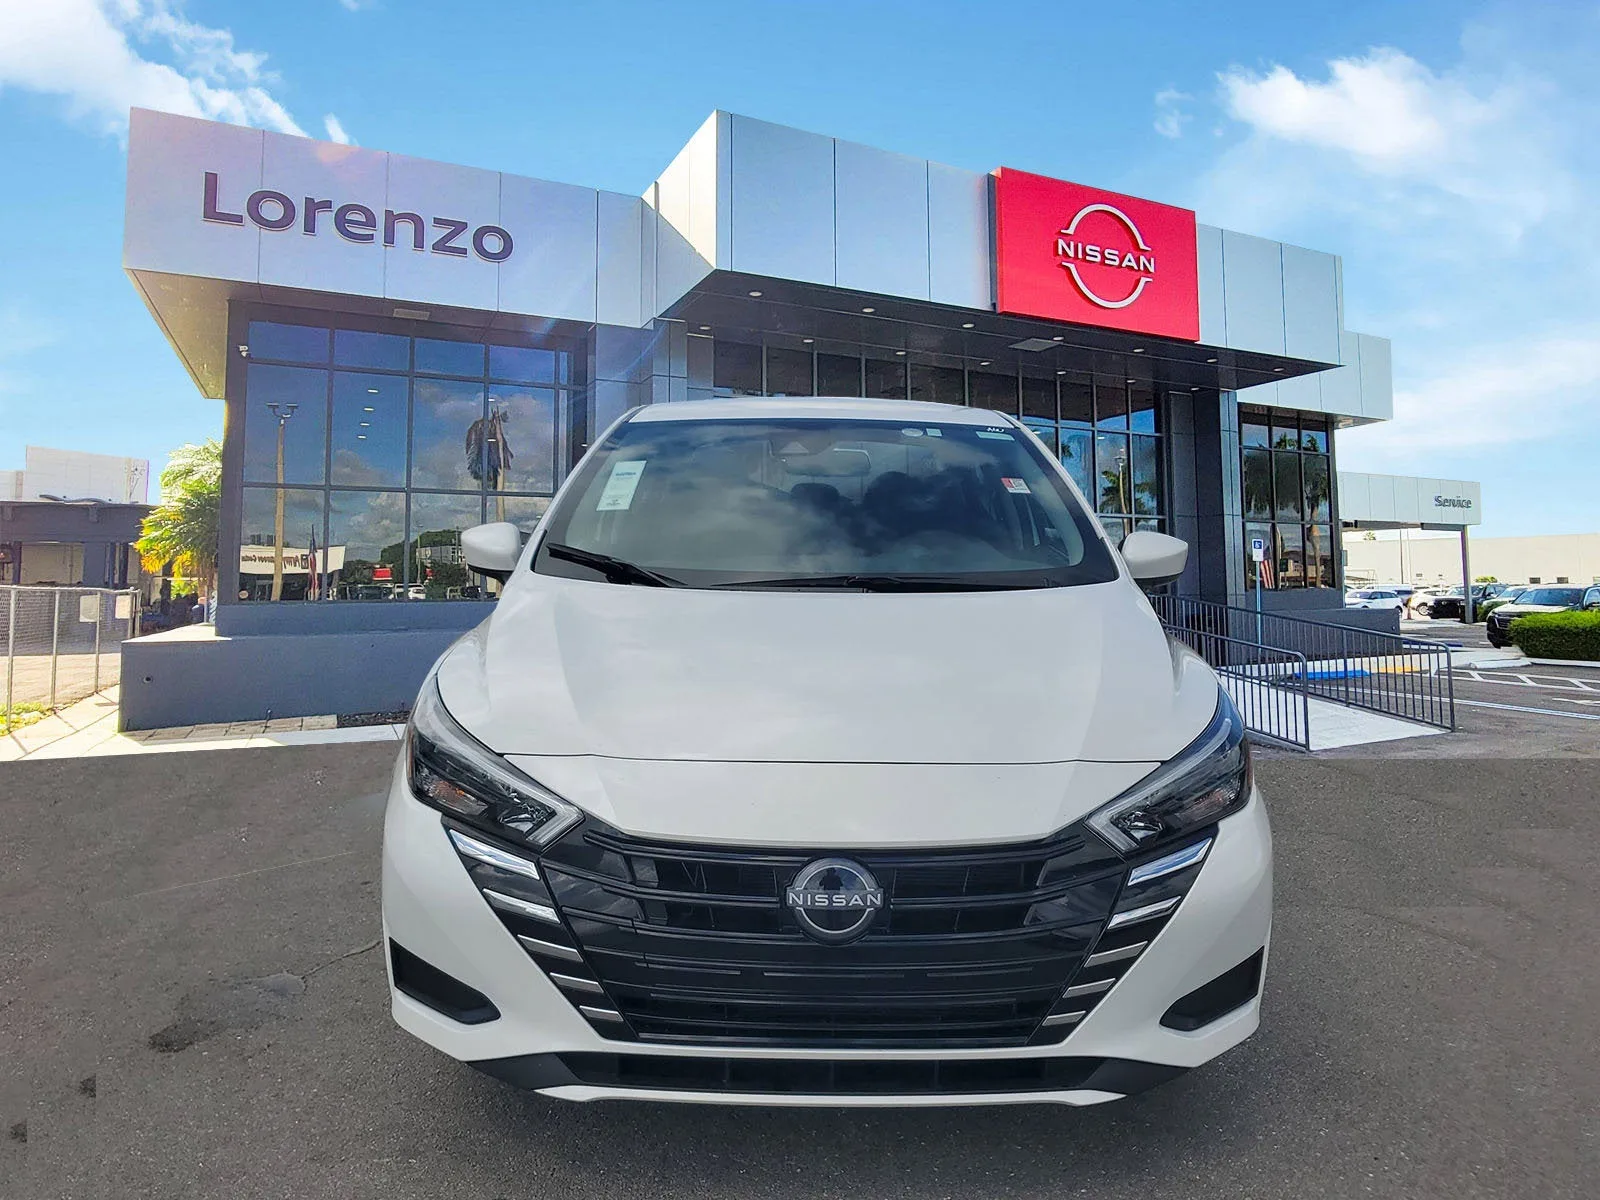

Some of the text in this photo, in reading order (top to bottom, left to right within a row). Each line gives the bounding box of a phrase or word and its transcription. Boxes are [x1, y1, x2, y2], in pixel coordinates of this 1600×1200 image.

[203, 171, 514, 262] Lorenzo
[1057, 238, 1155, 273] NISSAN
[1434, 495, 1472, 509] Service
[788, 892, 881, 906] NISSAN
